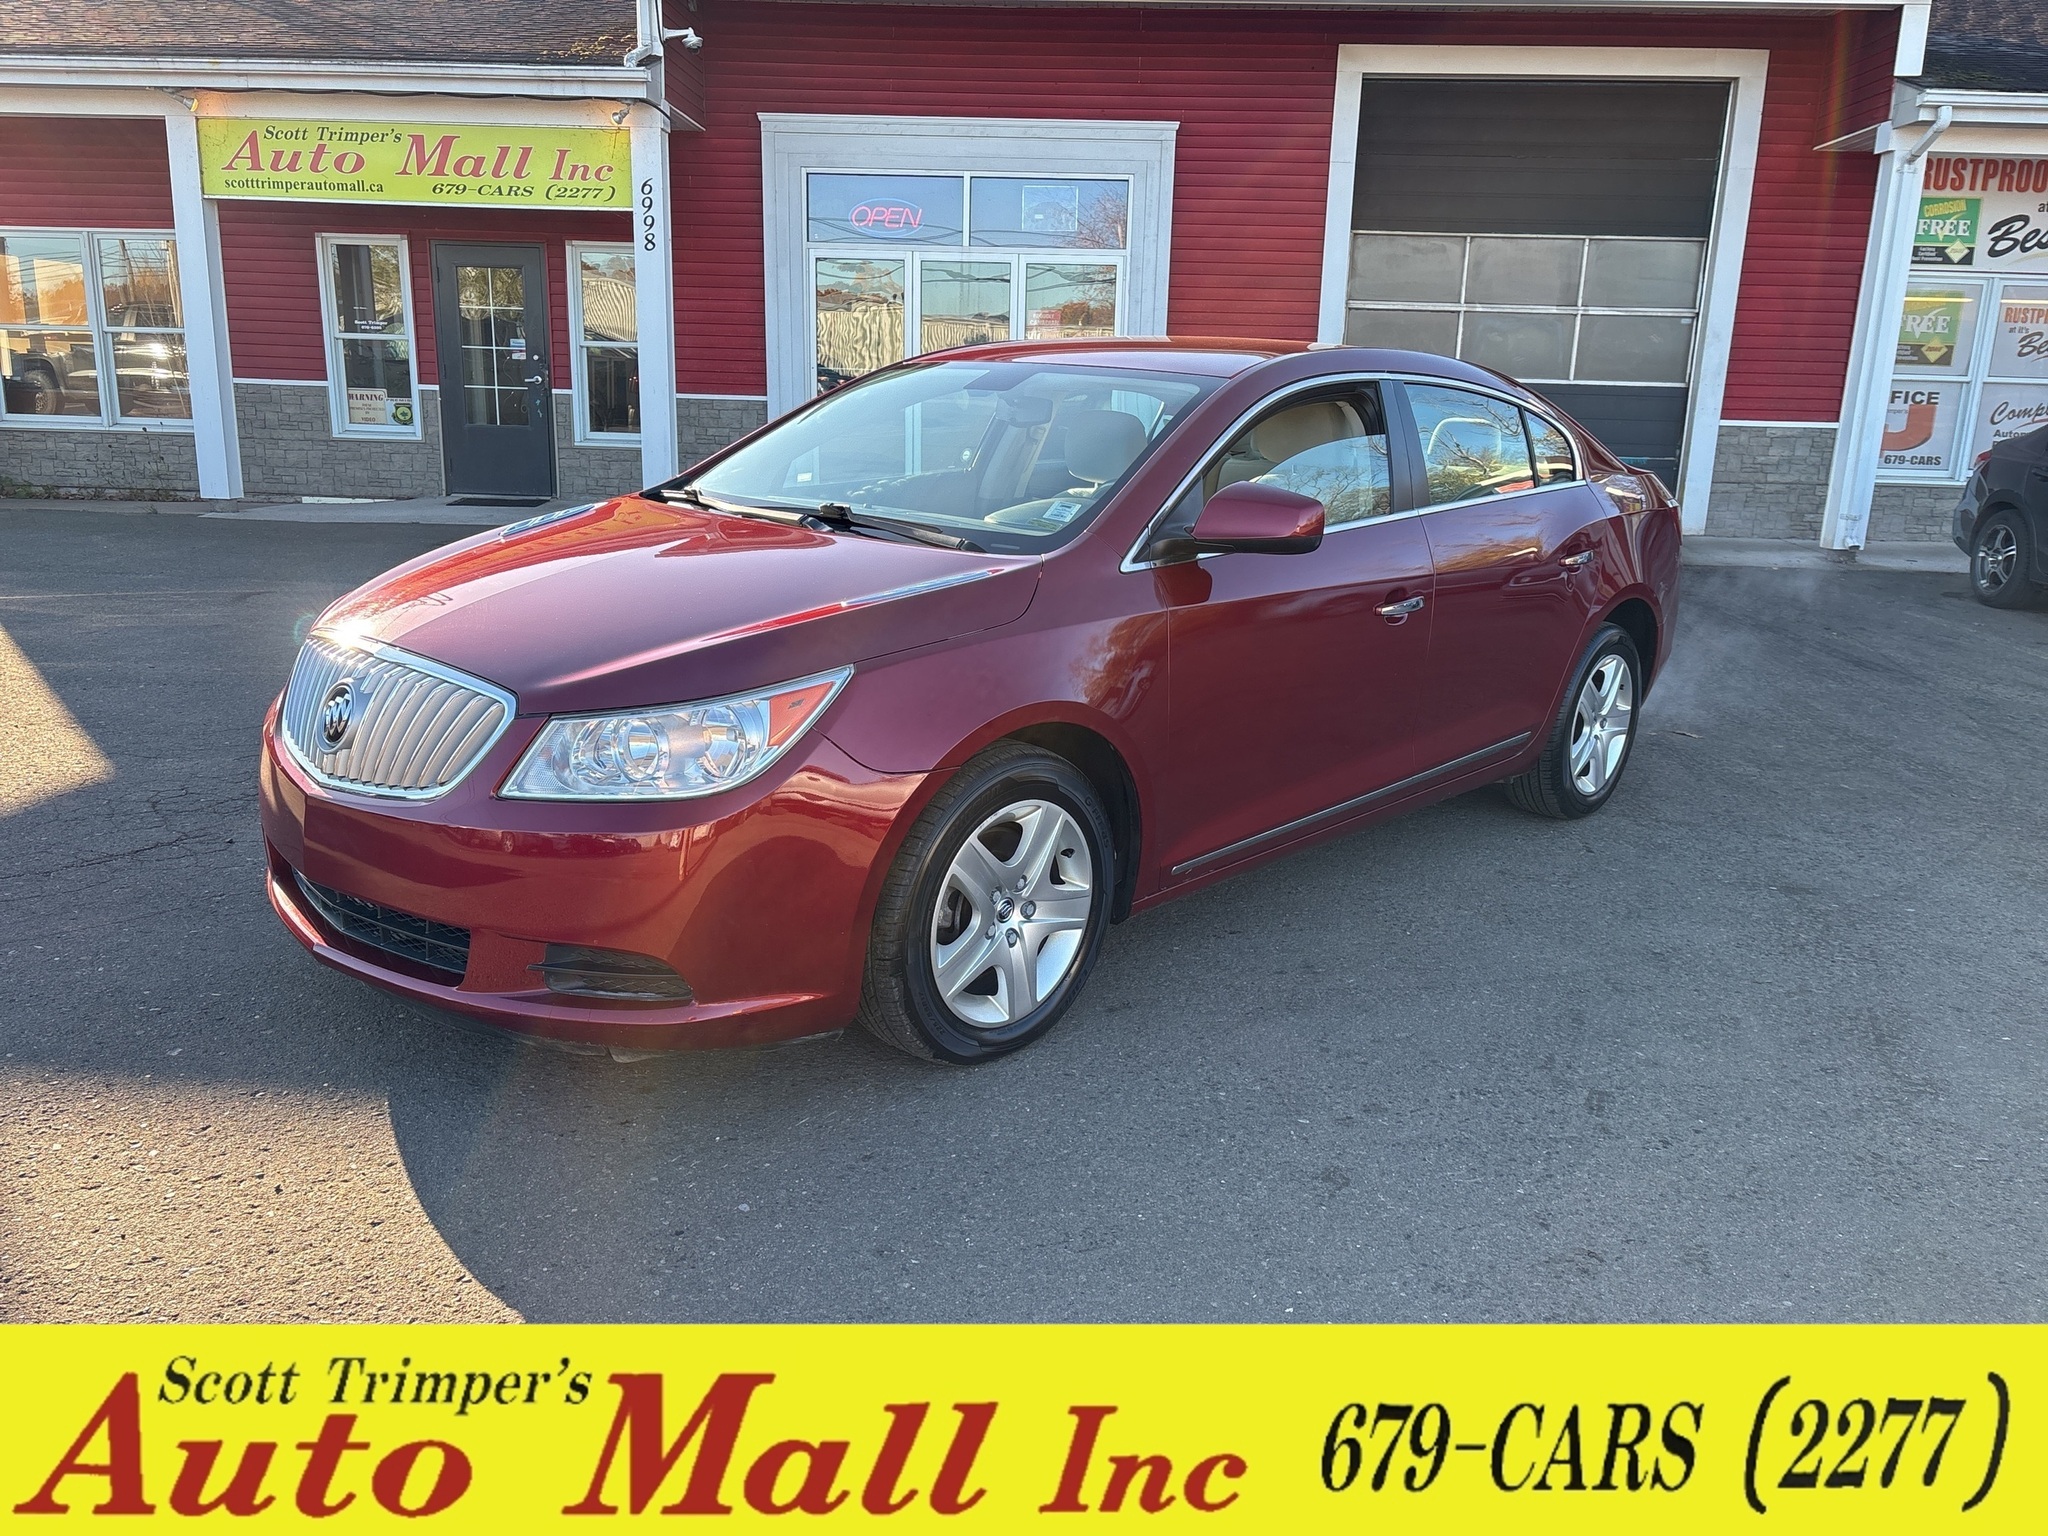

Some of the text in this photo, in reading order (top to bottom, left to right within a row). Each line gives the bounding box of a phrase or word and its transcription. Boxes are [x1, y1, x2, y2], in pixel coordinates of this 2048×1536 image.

[263, 125, 402, 145] Scott Trimper's
[221, 130, 615, 182] Auto Mall Inc
[224, 178, 384, 193] scotttrimperautomall.ca
[431, 182, 534, 197] 679-CARS
[640, 177, 656, 251] 6998
[851, 205, 923, 229] OPEN
[1923, 199, 1967, 217] CORROSION
[1916, 218, 1971, 236] FREE
[1990, 401, 2048, 425] Comp
[1883, 454, 1942, 466] 679-CARS
